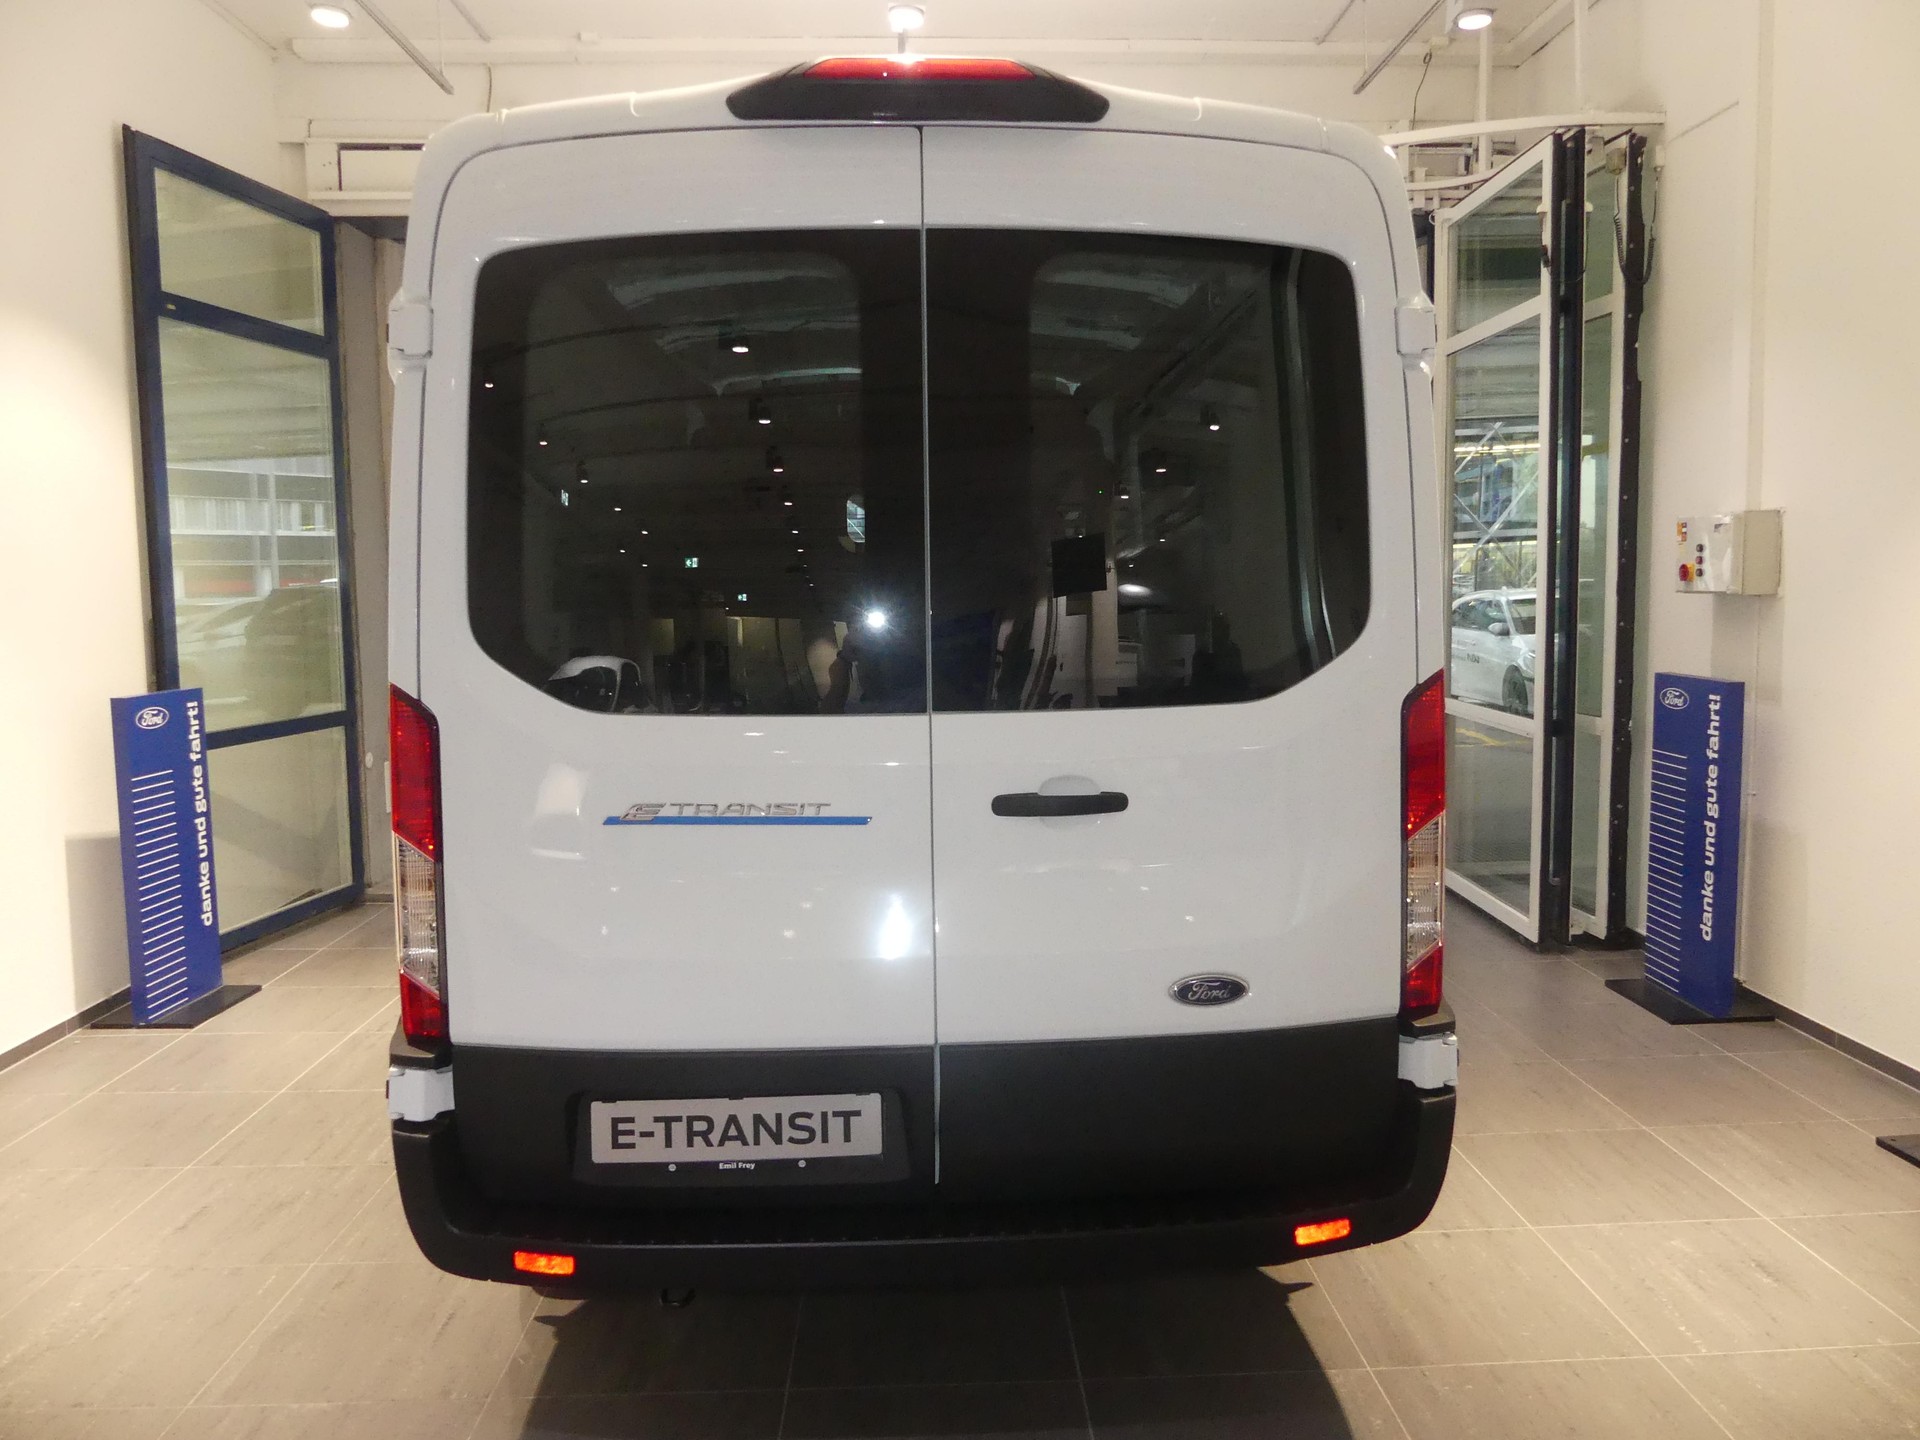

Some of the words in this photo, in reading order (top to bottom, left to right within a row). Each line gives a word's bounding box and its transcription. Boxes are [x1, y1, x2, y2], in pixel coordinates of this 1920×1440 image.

[141, 709, 164, 726] Ford
[1664, 689, 1685, 707] Ford
[186, 701, 202, 762] fahrt!
[1706, 694, 1721, 760] fahrt!
[192, 764, 207, 813] gute
[670, 803, 832, 816] TRANSIT
[1705, 764, 1719, 819] gute
[194, 816, 208, 859] und
[1703, 820, 1716, 866] und
[199, 861, 213, 927] danke
[1700, 870, 1714, 941] danke
[1187, 982, 1232, 1000] Ford
[610, 1109, 862, 1150] E-TRANSIT
[719, 1162, 737, 1170] Emil
[738, 1162, 756, 1170] Frey
